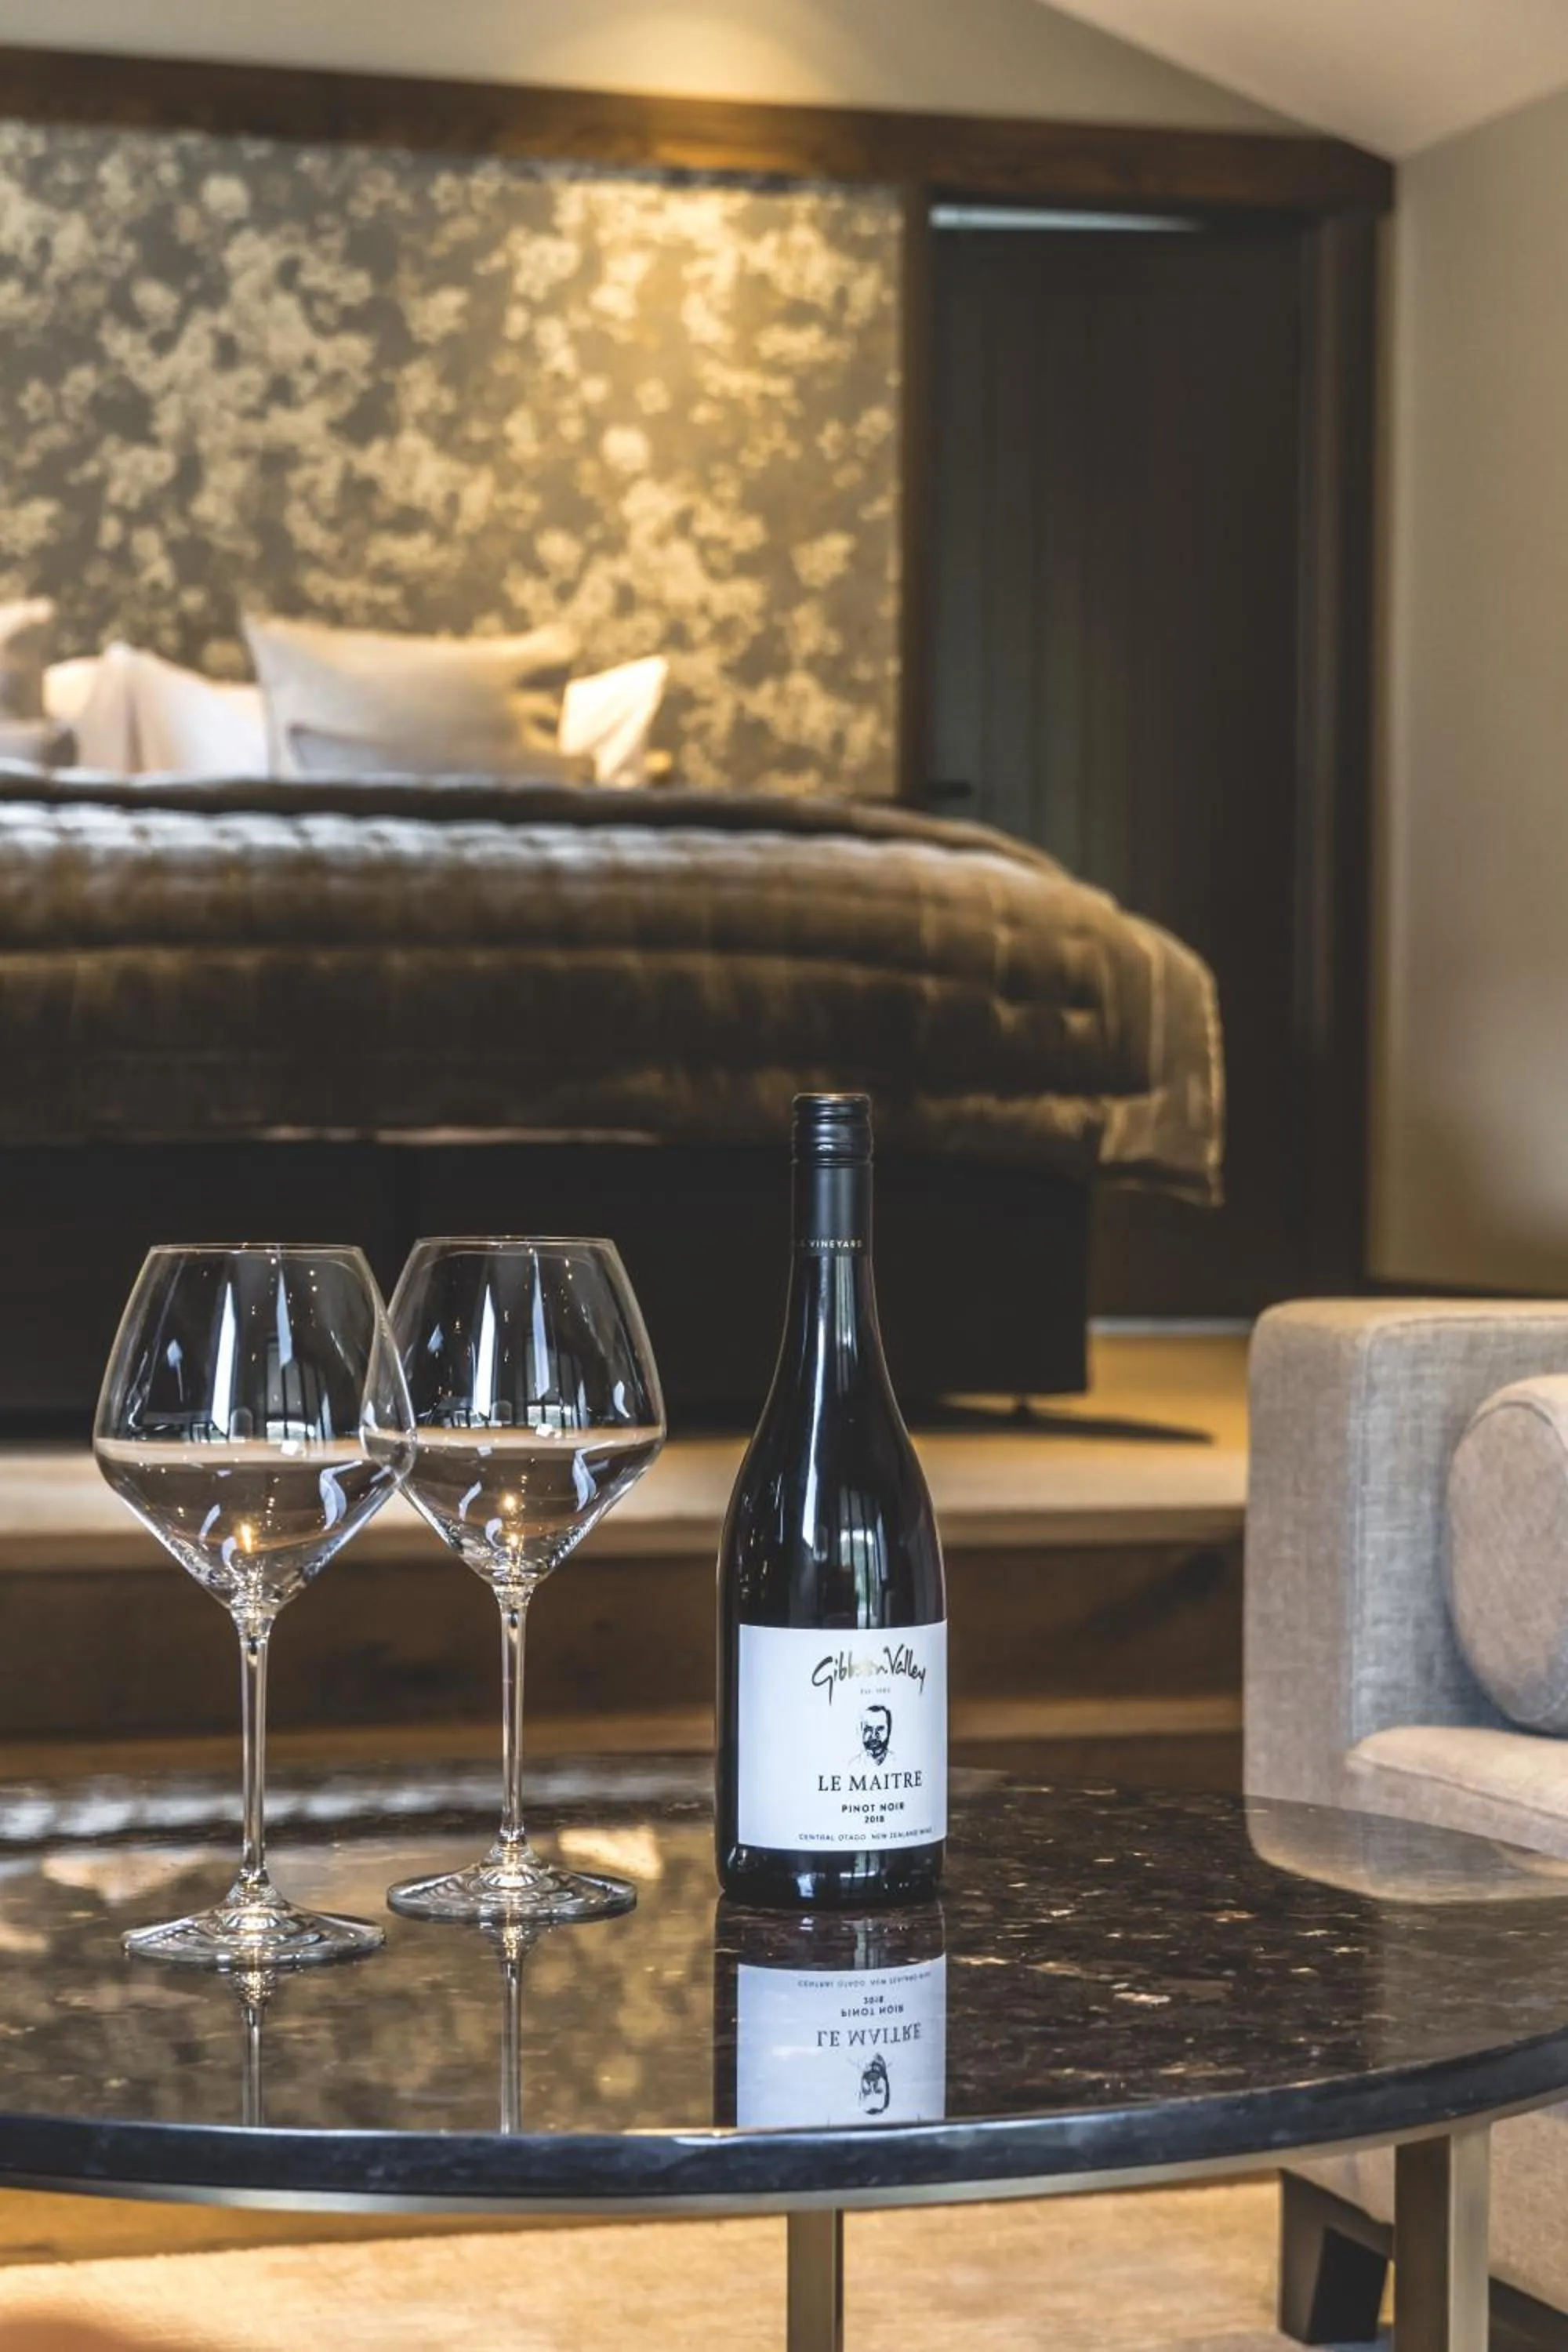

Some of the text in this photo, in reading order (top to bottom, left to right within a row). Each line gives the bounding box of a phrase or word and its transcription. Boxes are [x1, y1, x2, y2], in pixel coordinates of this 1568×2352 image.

[811, 1643, 927, 1706] Gibbn Valley
[818, 1770, 924, 1791] LE MAITRE
[841, 1802, 905, 1813] PINOT NOIR
[864, 1815, 885, 1824] 2018
